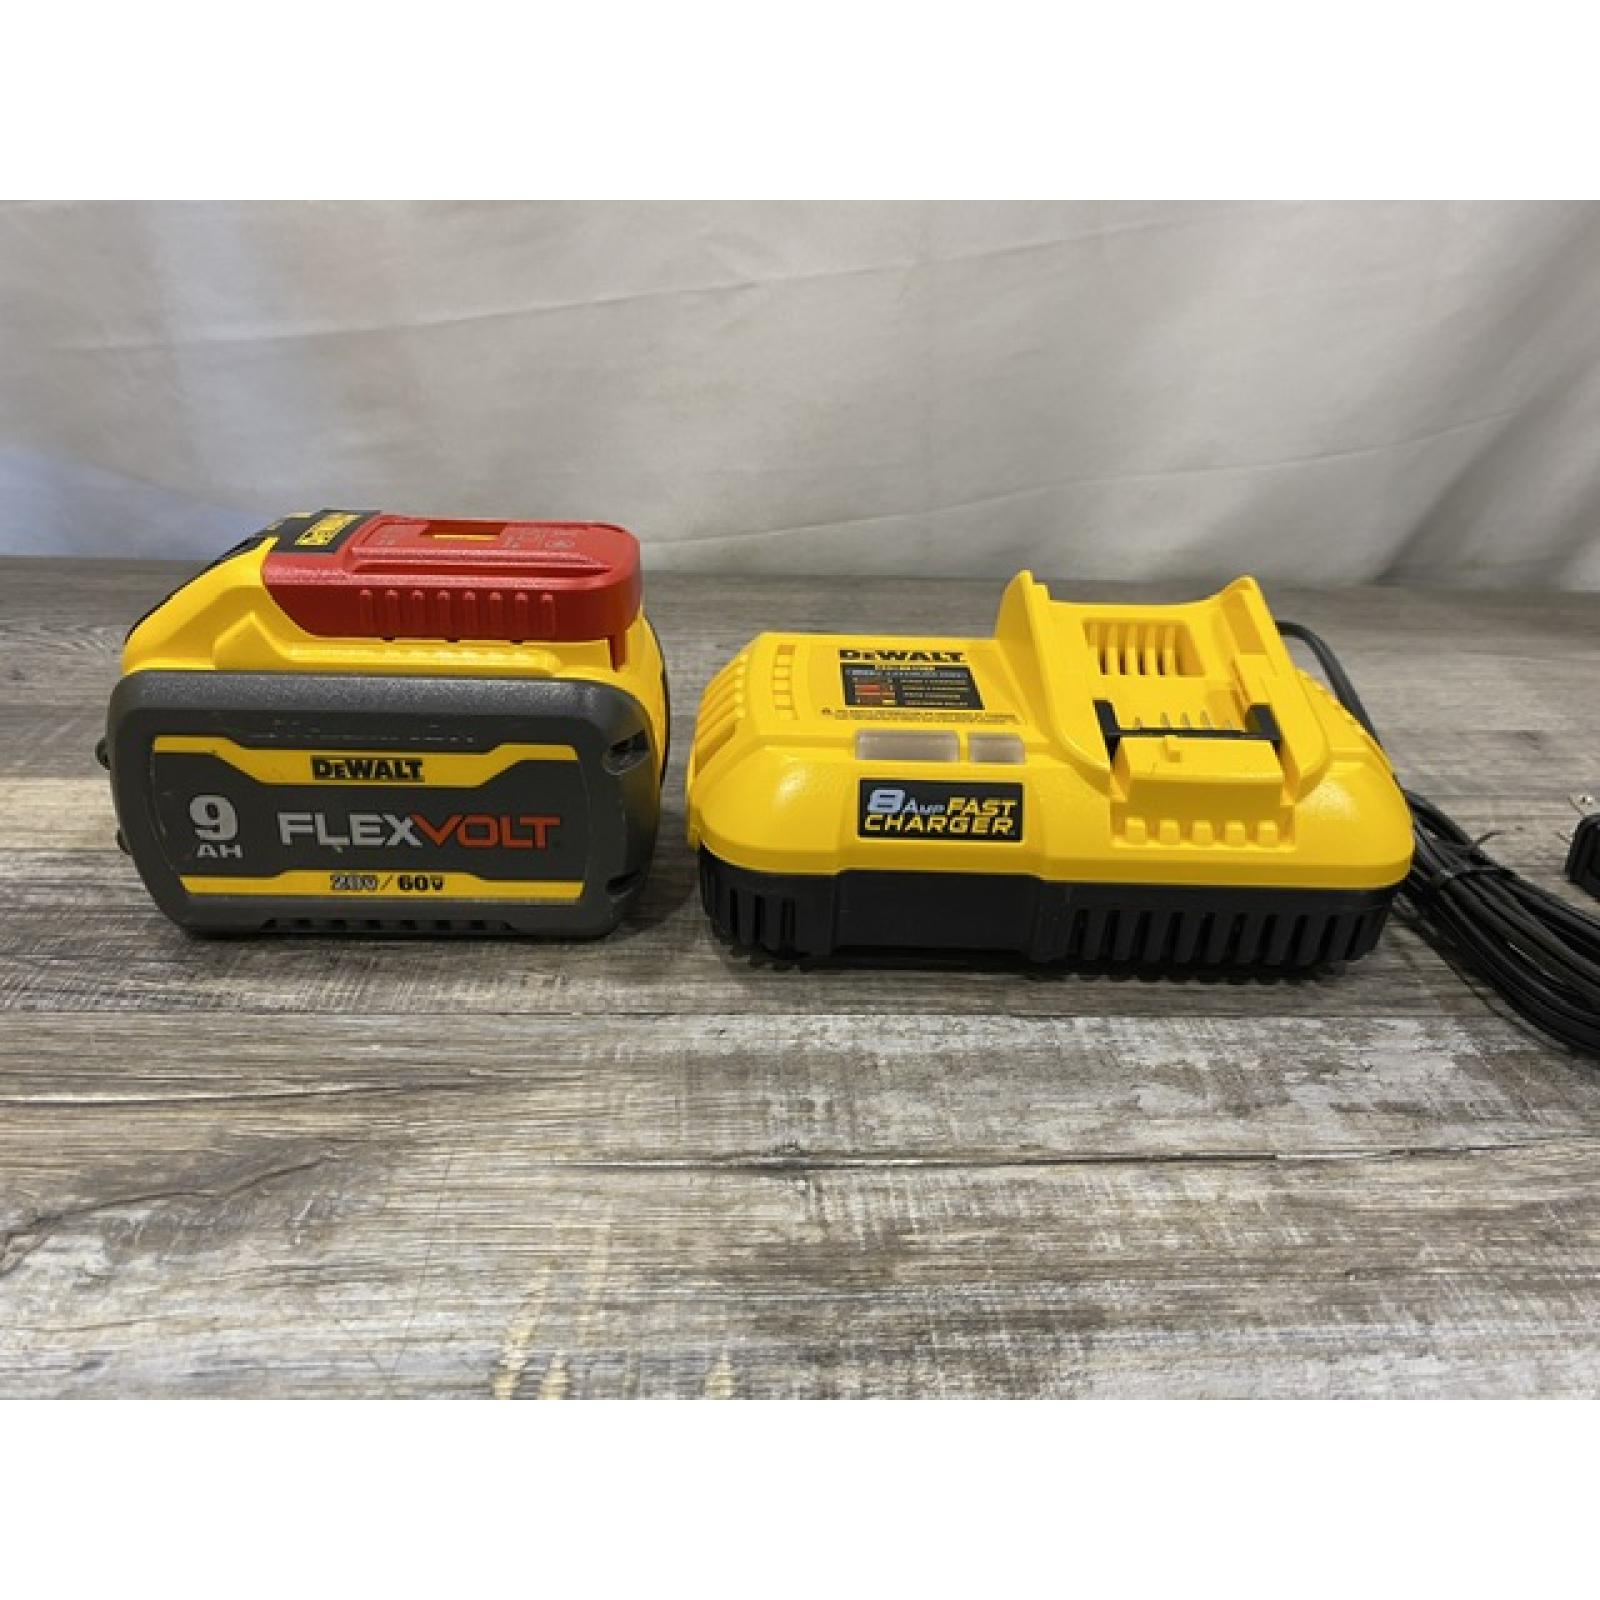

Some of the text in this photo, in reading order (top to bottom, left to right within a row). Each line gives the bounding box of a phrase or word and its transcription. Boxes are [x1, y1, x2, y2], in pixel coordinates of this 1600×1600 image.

[867, 790, 905, 813] 8
[947, 798, 1017, 816] FAST
[189, 794, 239, 841] 9
[277, 811, 562, 849] FLEXVOLT
[864, 814, 1015, 835] CHARGER
[197, 844, 243, 858] AH
